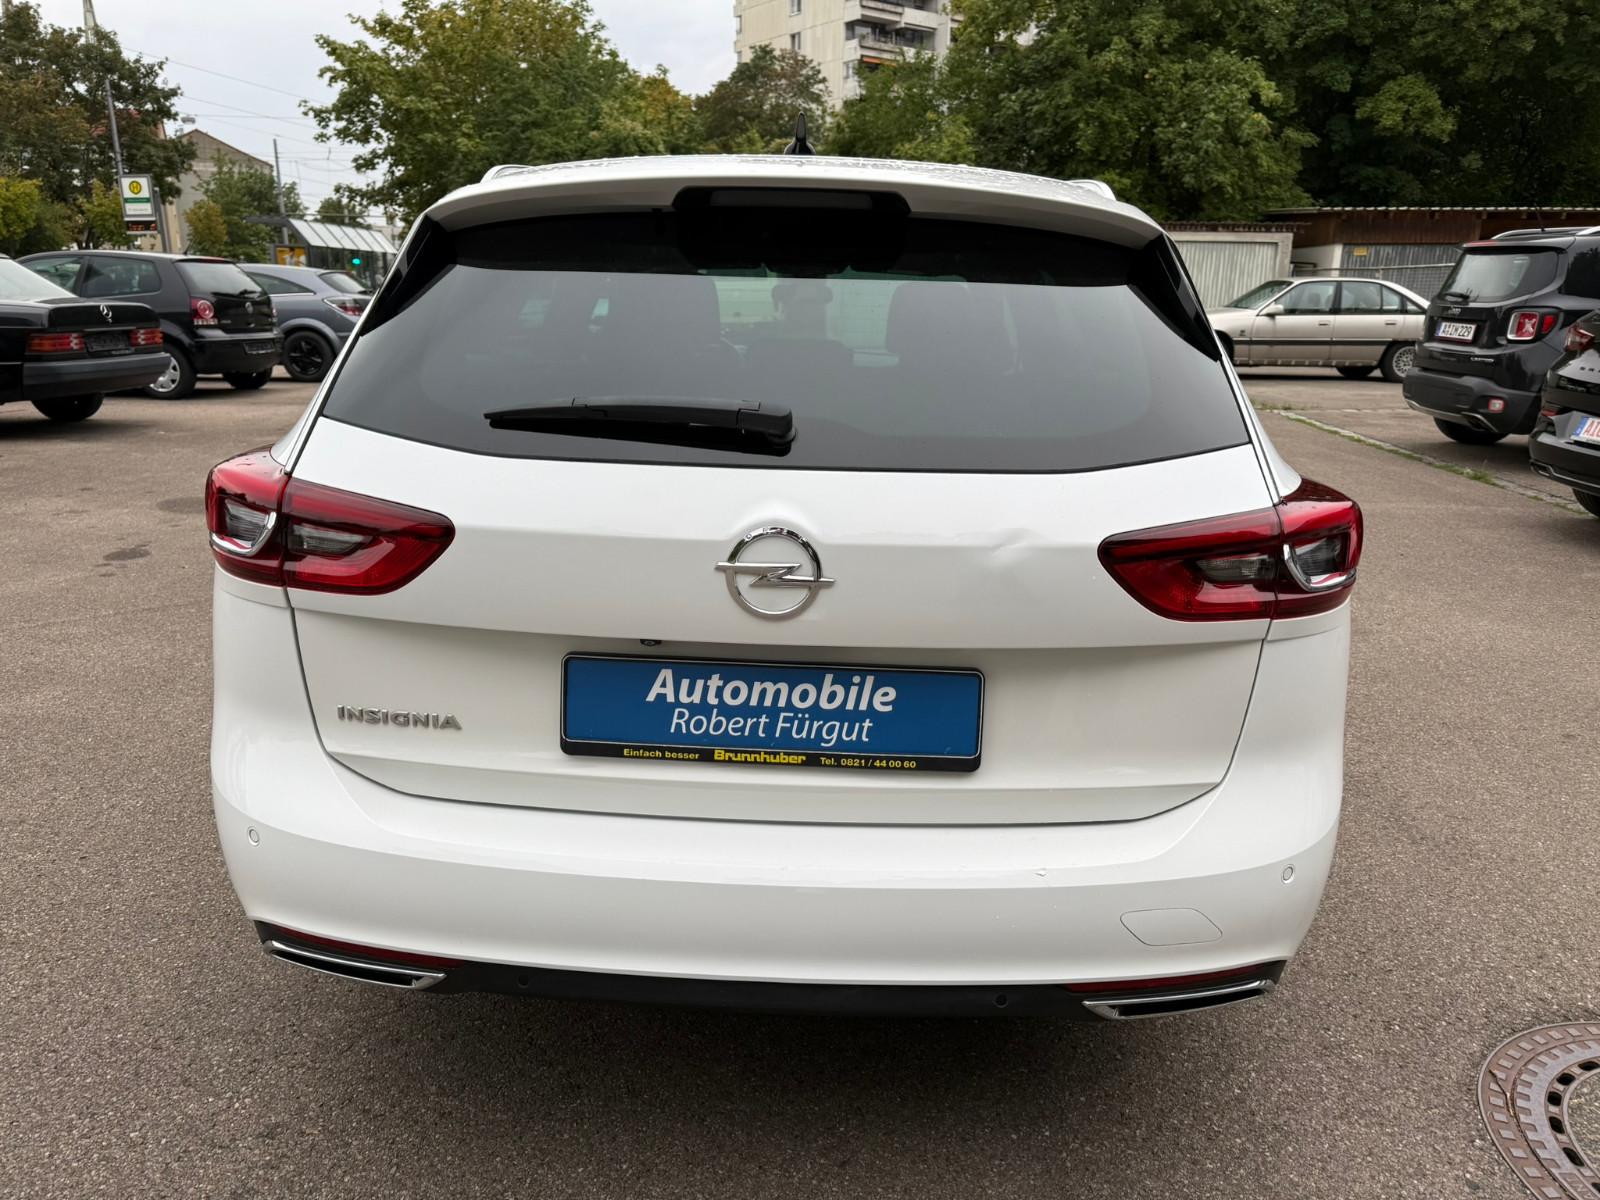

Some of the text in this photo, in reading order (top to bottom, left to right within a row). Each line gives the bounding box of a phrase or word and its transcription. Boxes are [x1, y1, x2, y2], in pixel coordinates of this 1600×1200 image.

[646, 668, 897, 712] Automobile
[337, 705, 462, 730] INSIGNIA
[670, 707, 873, 747] Robert Fürgut
[623, 749, 662, 758] Einfach
[665, 751, 700, 760] besser
[713, 749, 807, 764] Brunnhuber
[820, 757, 838, 766] Tel.
[840, 758, 866, 767] 0821
[873, 760, 887, 768] 44
[889, 760, 901, 768] 00
[903, 761, 917, 769] 60
